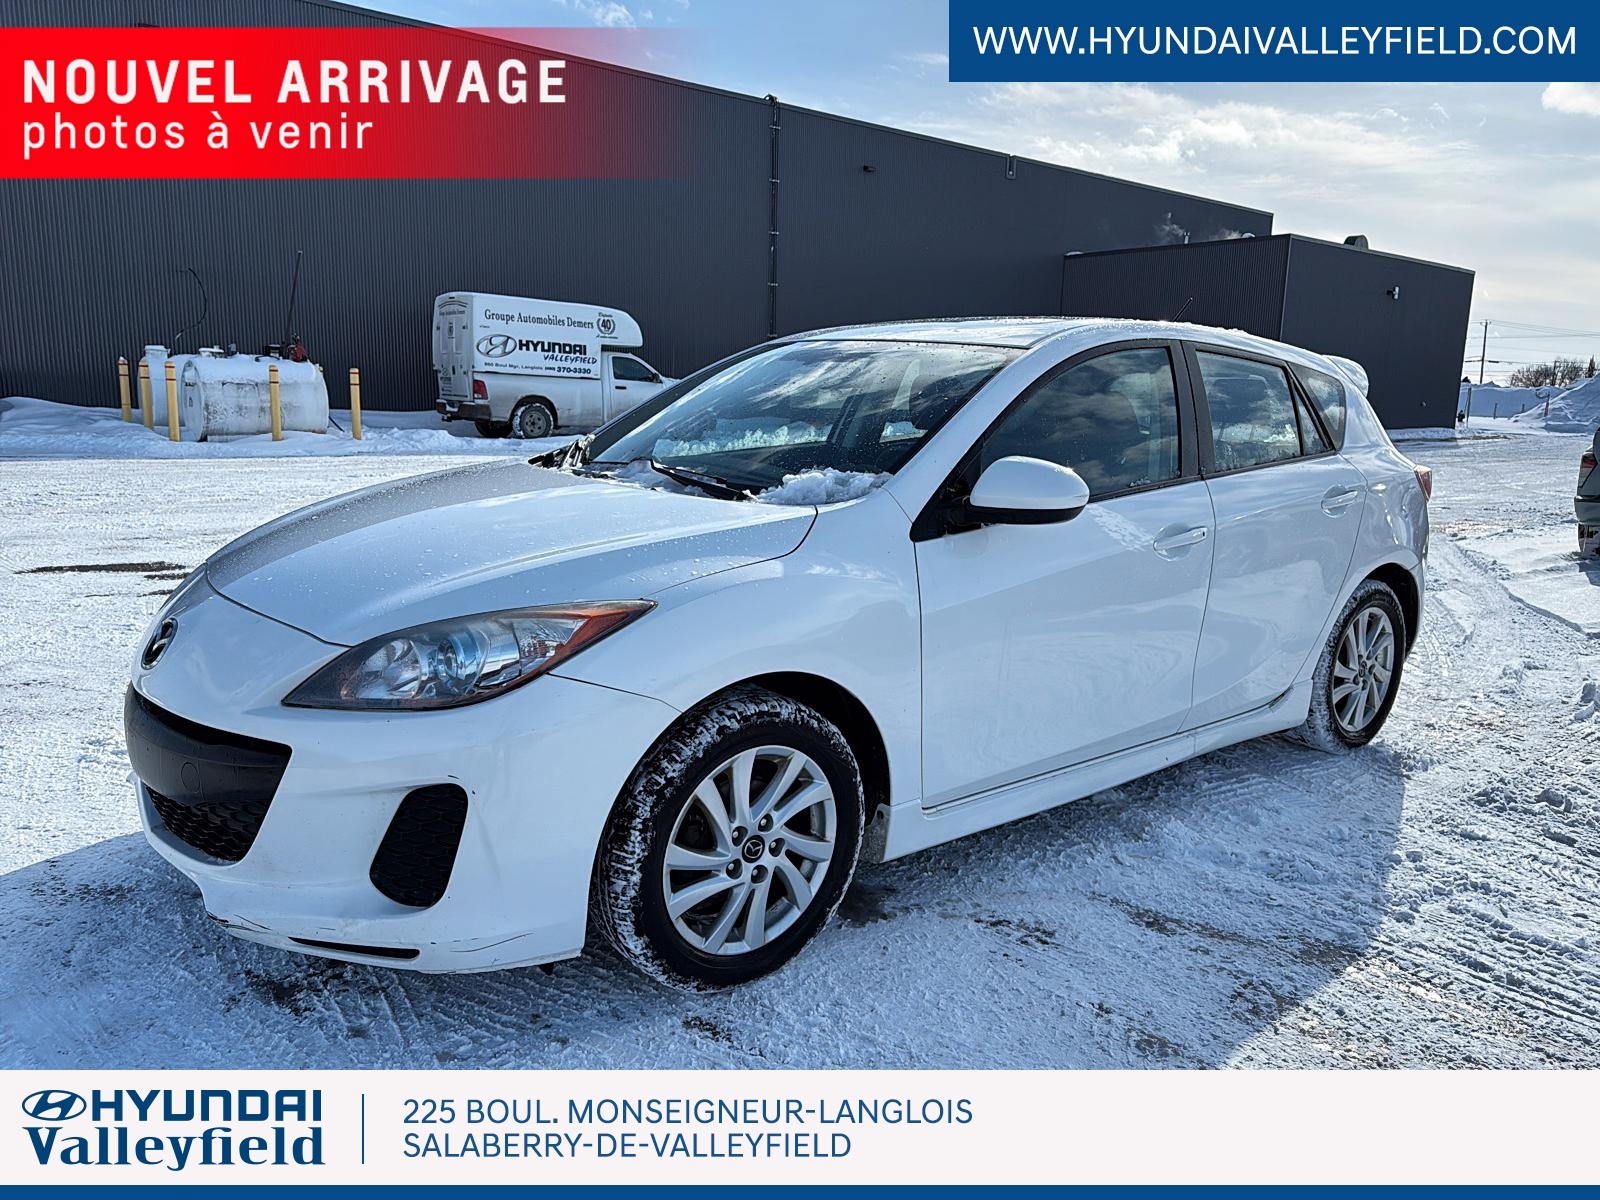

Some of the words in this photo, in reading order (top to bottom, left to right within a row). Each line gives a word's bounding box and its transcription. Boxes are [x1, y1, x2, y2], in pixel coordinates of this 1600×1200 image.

[484, 309, 515, 325] Groupe
[517, 312, 566, 327] Automobiles
[567, 317, 594, 329] Demers
[601, 319, 612, 331] 40
[518, 339, 587, 355] HYUNDAI
[543, 353, 598, 365] VALLEYFIELD
[556, 366, 592, 375] 370-3330
